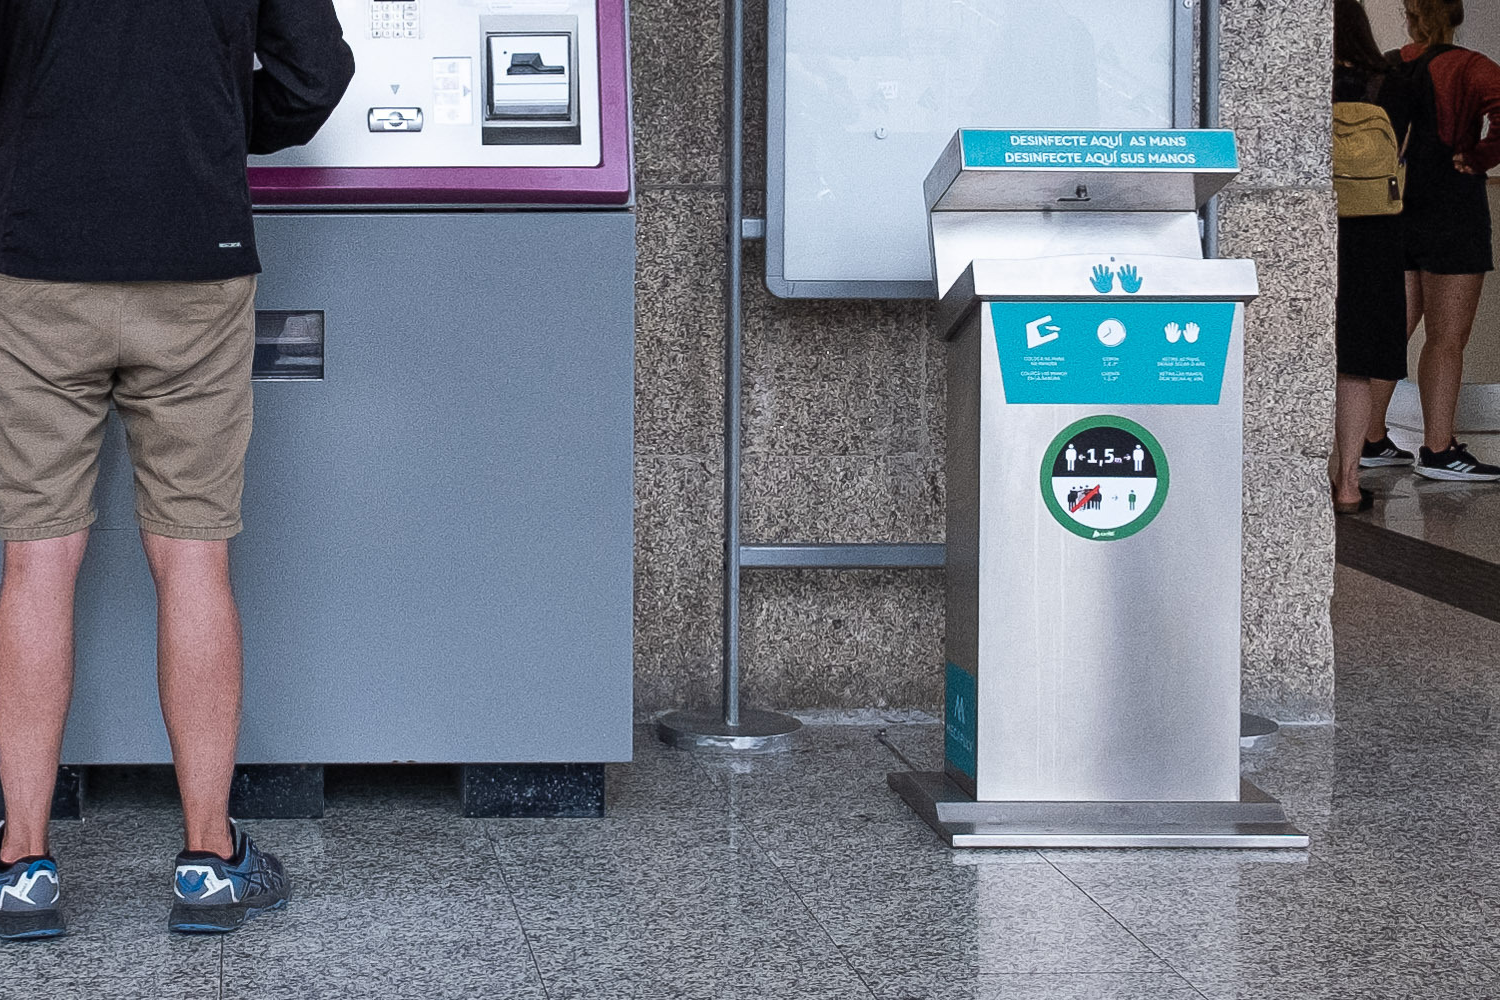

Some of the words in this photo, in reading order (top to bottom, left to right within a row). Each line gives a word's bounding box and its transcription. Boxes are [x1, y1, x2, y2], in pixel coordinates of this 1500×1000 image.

[1010, 135, 1087, 146] DESINFECTE
[1090, 133, 1122, 149] AQUÍ
[1129, 136, 1147, 146] AS
[1149, 136, 1187, 147] MANS
[1005, 152, 1082, 163] DESINFECTE
[1085, 150, 1117, 166] AQUÍ
[1120, 152, 1145, 164] SUS
[1148, 153, 1196, 164] MANOS
